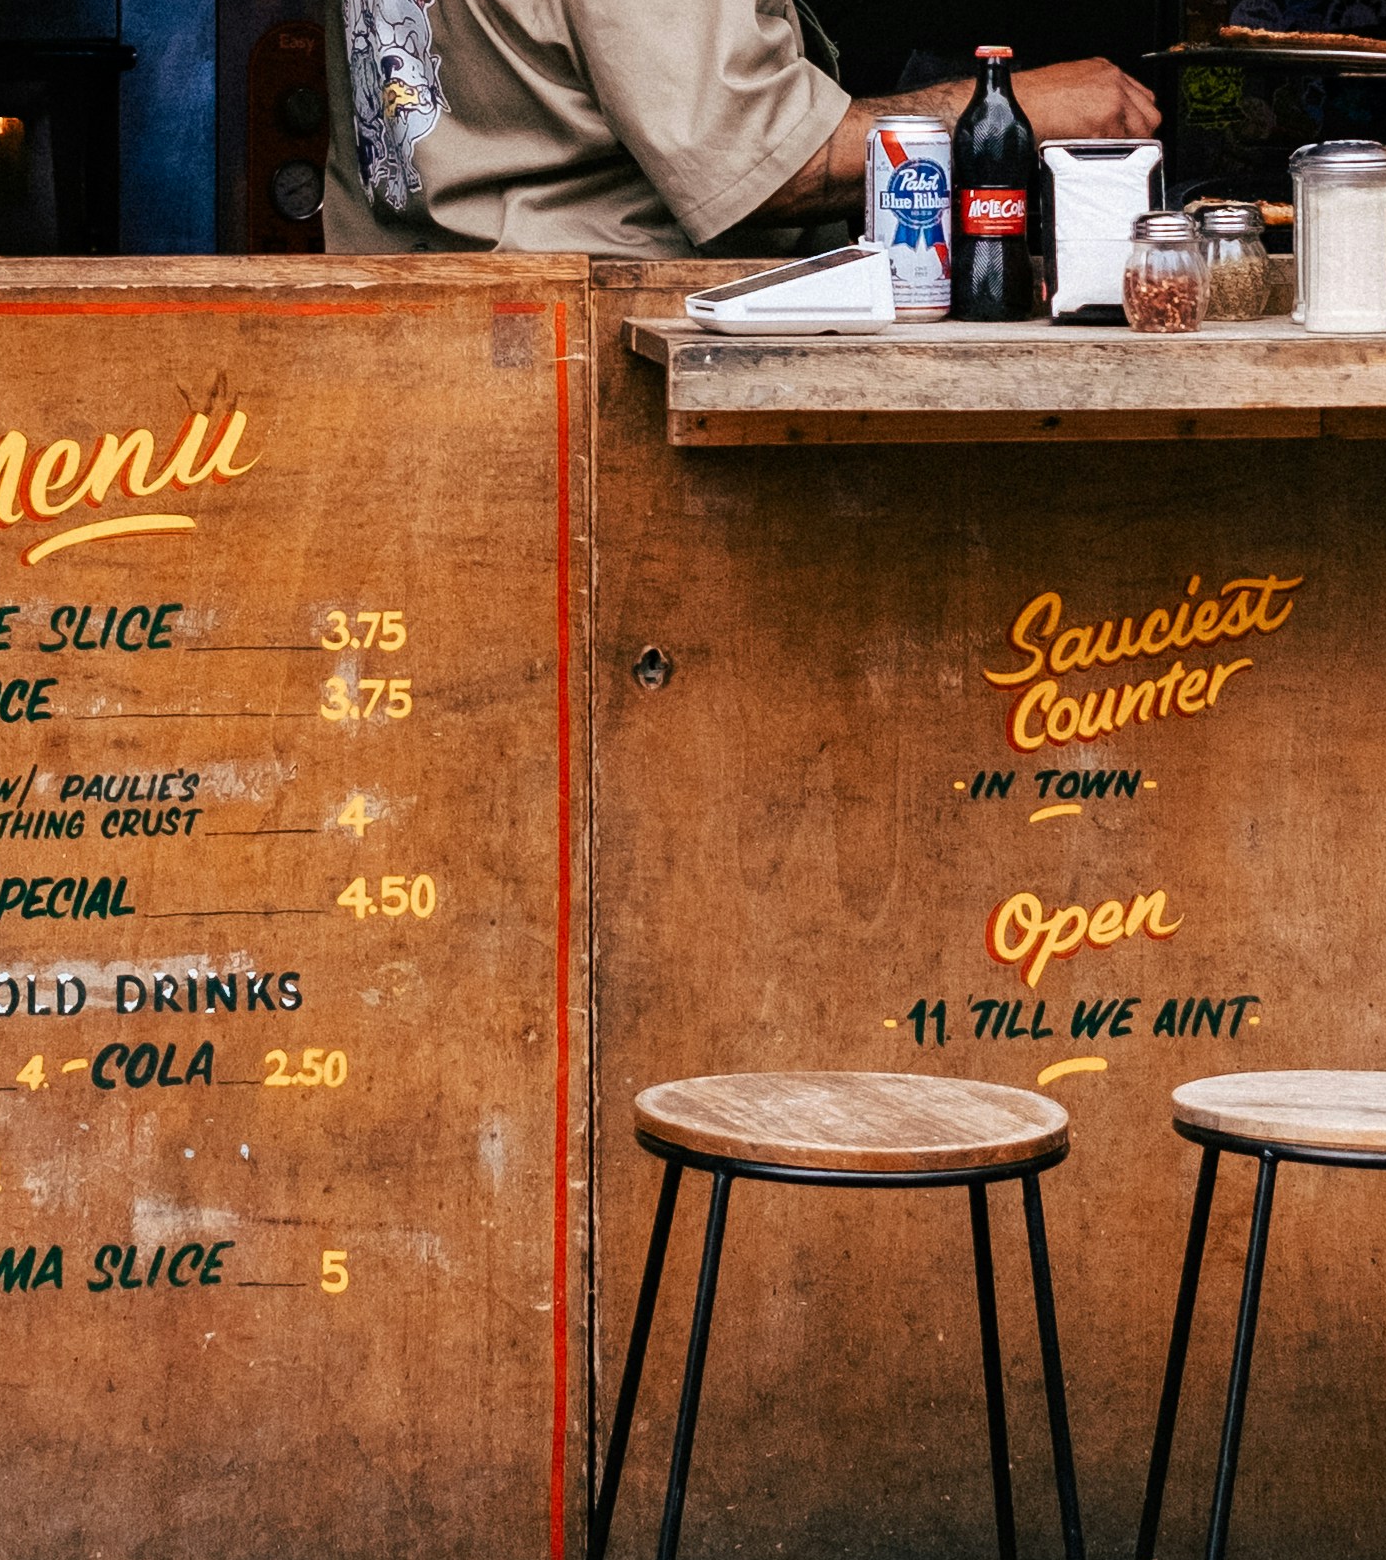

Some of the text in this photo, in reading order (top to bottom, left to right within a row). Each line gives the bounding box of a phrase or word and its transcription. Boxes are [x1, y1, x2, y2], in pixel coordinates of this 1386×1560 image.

[881, 192, 912, 209] Blue
[899, 169, 940, 191] Pabst
[39, 604, 182, 652] SLICE
[322, 611, 406, 650] 3.75
[985, 575, 1306, 687] Sauciest
[321, 677, 411, 720] 3.75
[1007, 659, 1254, 753] Counter
[60, 769, 199, 802] PAULIE'S
[971, 770, 1141, 800] IN TOWN
[101, 807, 202, 838] CRUST
[338, 796, 373, 837] 4
[338, 875, 435, 918] 4.50
[986, 890, 1183, 988] Open
[117, 972, 302, 1013] DRINKS
[1071, 998, 1141, 1039] WE
[1153, 996, 1259, 1038] AINT
[92, 1042, 213, 1089] COLA
[265, 1049, 347, 1086] 2.50
[87, 1241, 234, 1292] SLICE
[322, 1251, 348, 1292] 5
